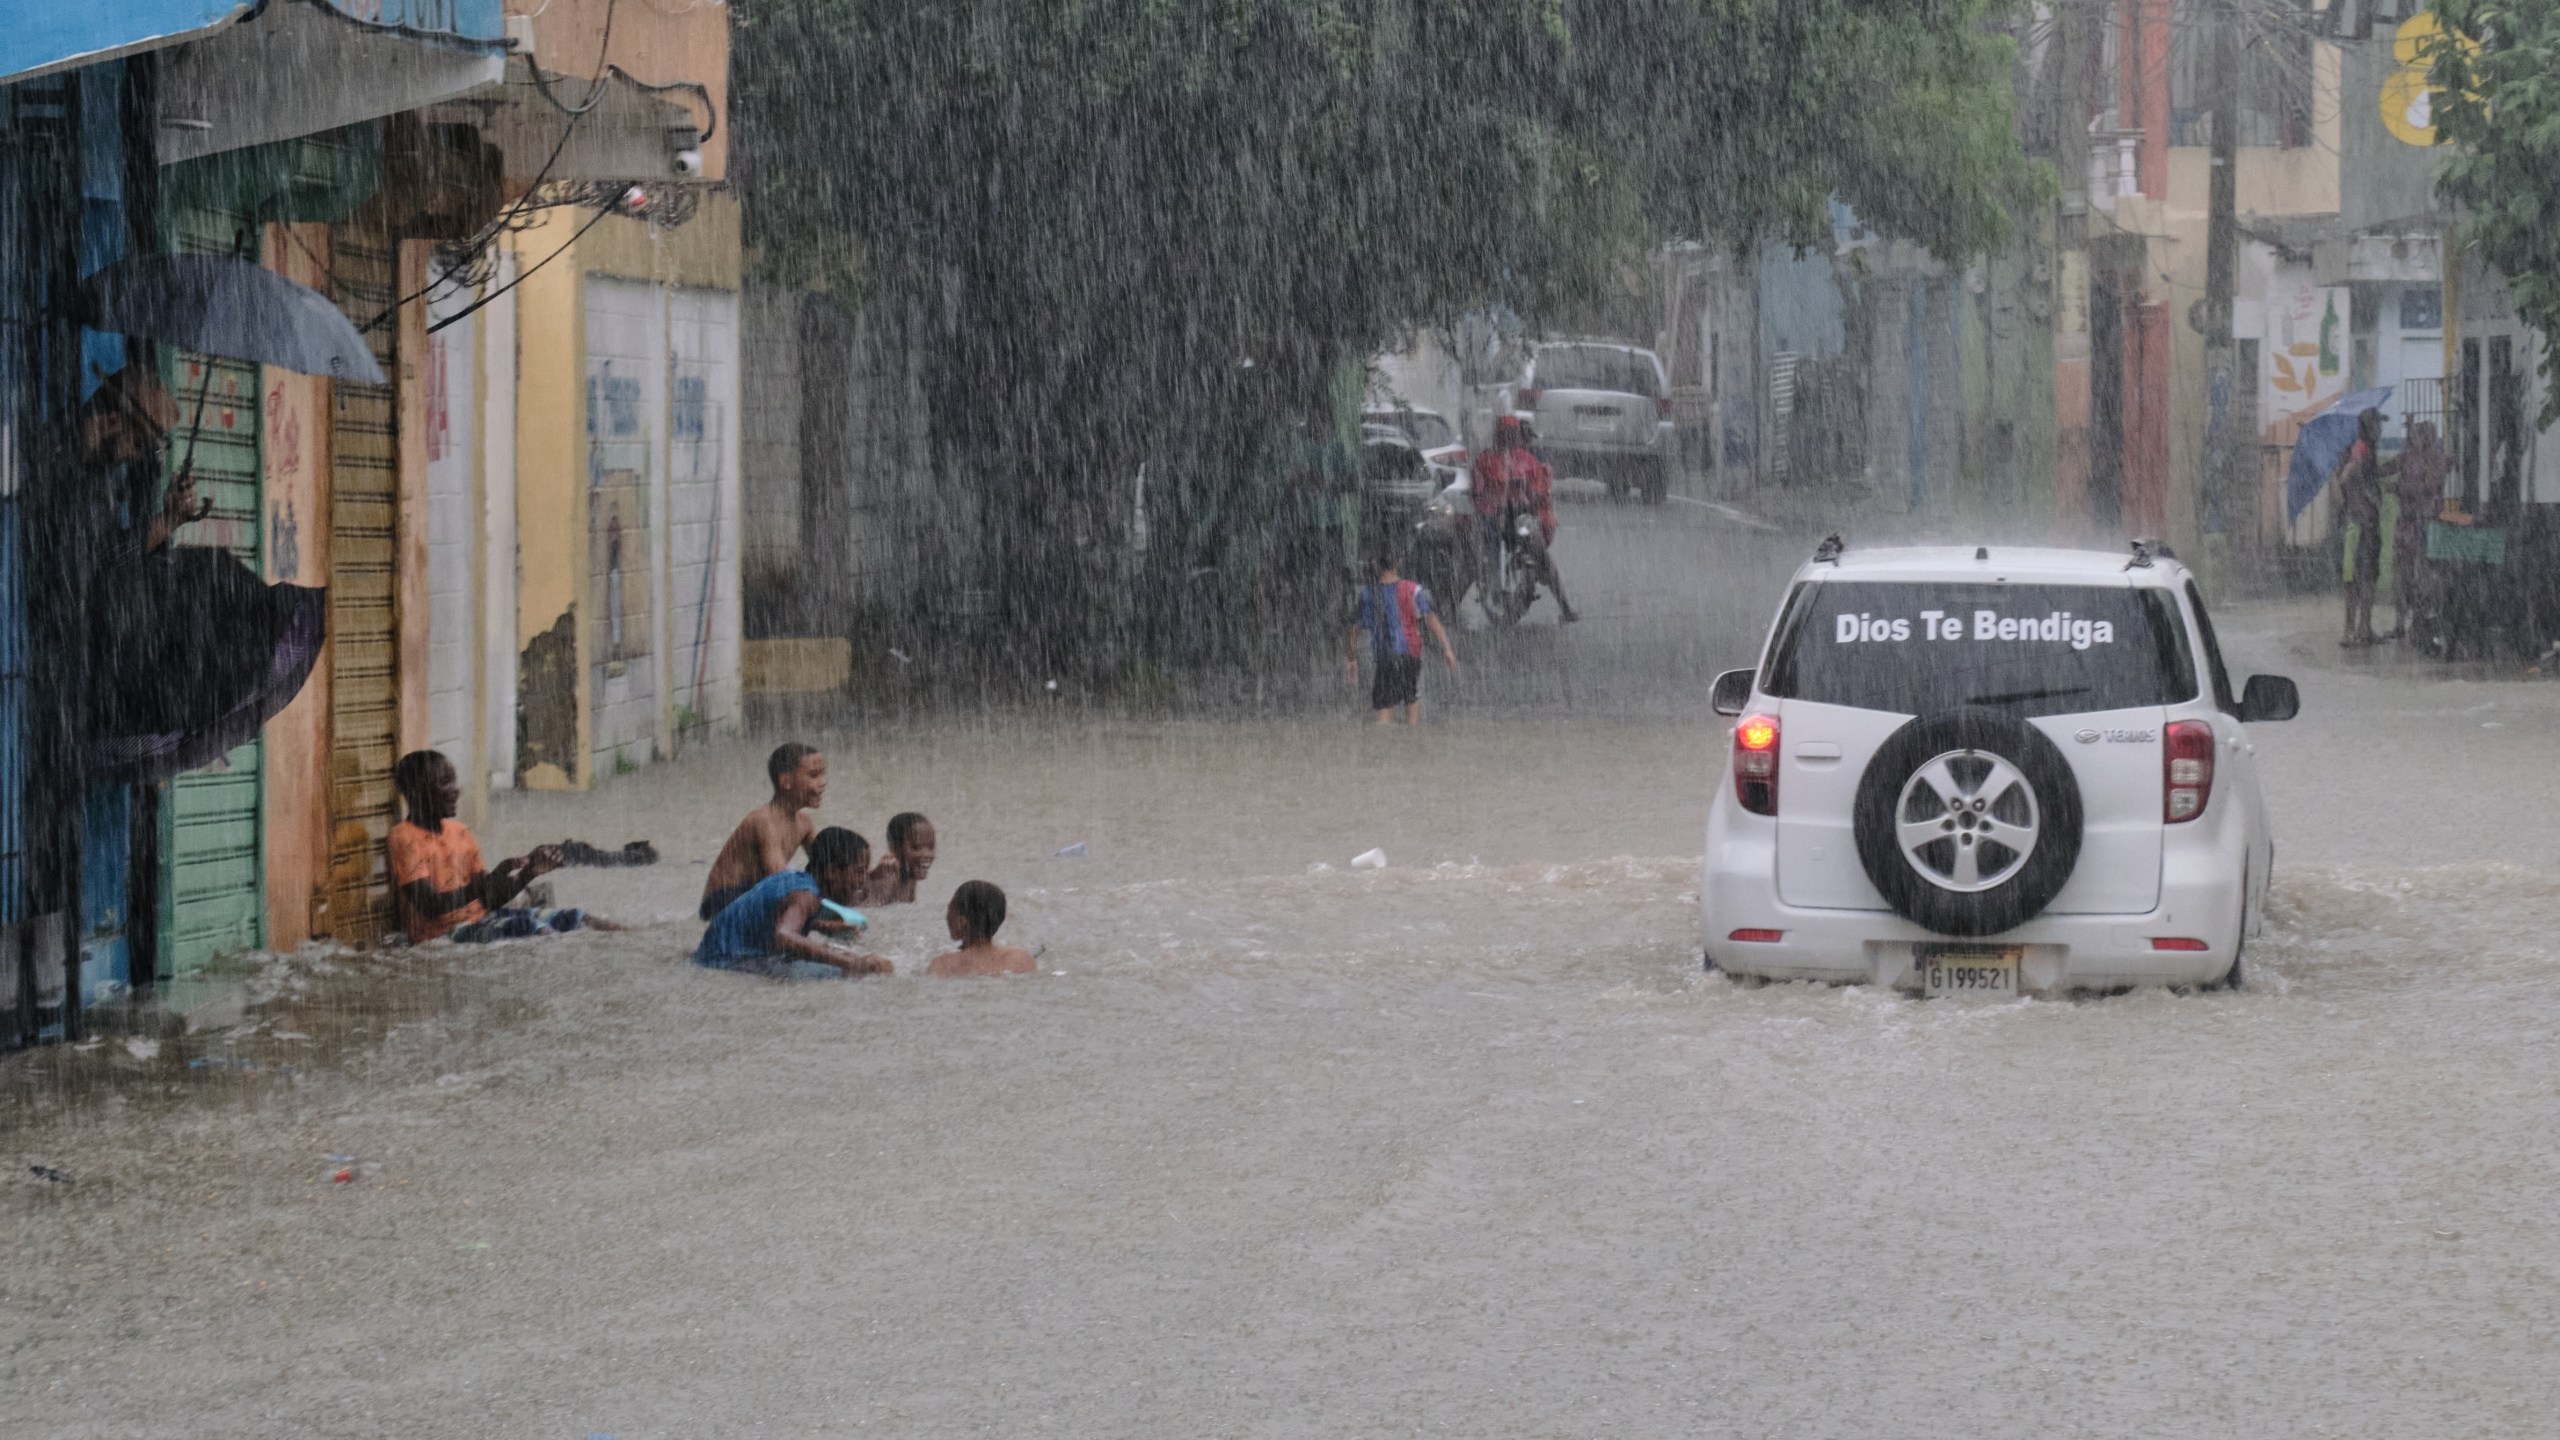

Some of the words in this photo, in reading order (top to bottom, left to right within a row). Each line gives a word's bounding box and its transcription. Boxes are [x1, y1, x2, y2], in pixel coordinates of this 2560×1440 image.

[1836, 613, 1911, 643] Dios
[1920, 610, 1963, 641] Te
[1974, 610, 2114, 650] Bendiga
[2104, 729, 2156, 743] TERIOS
